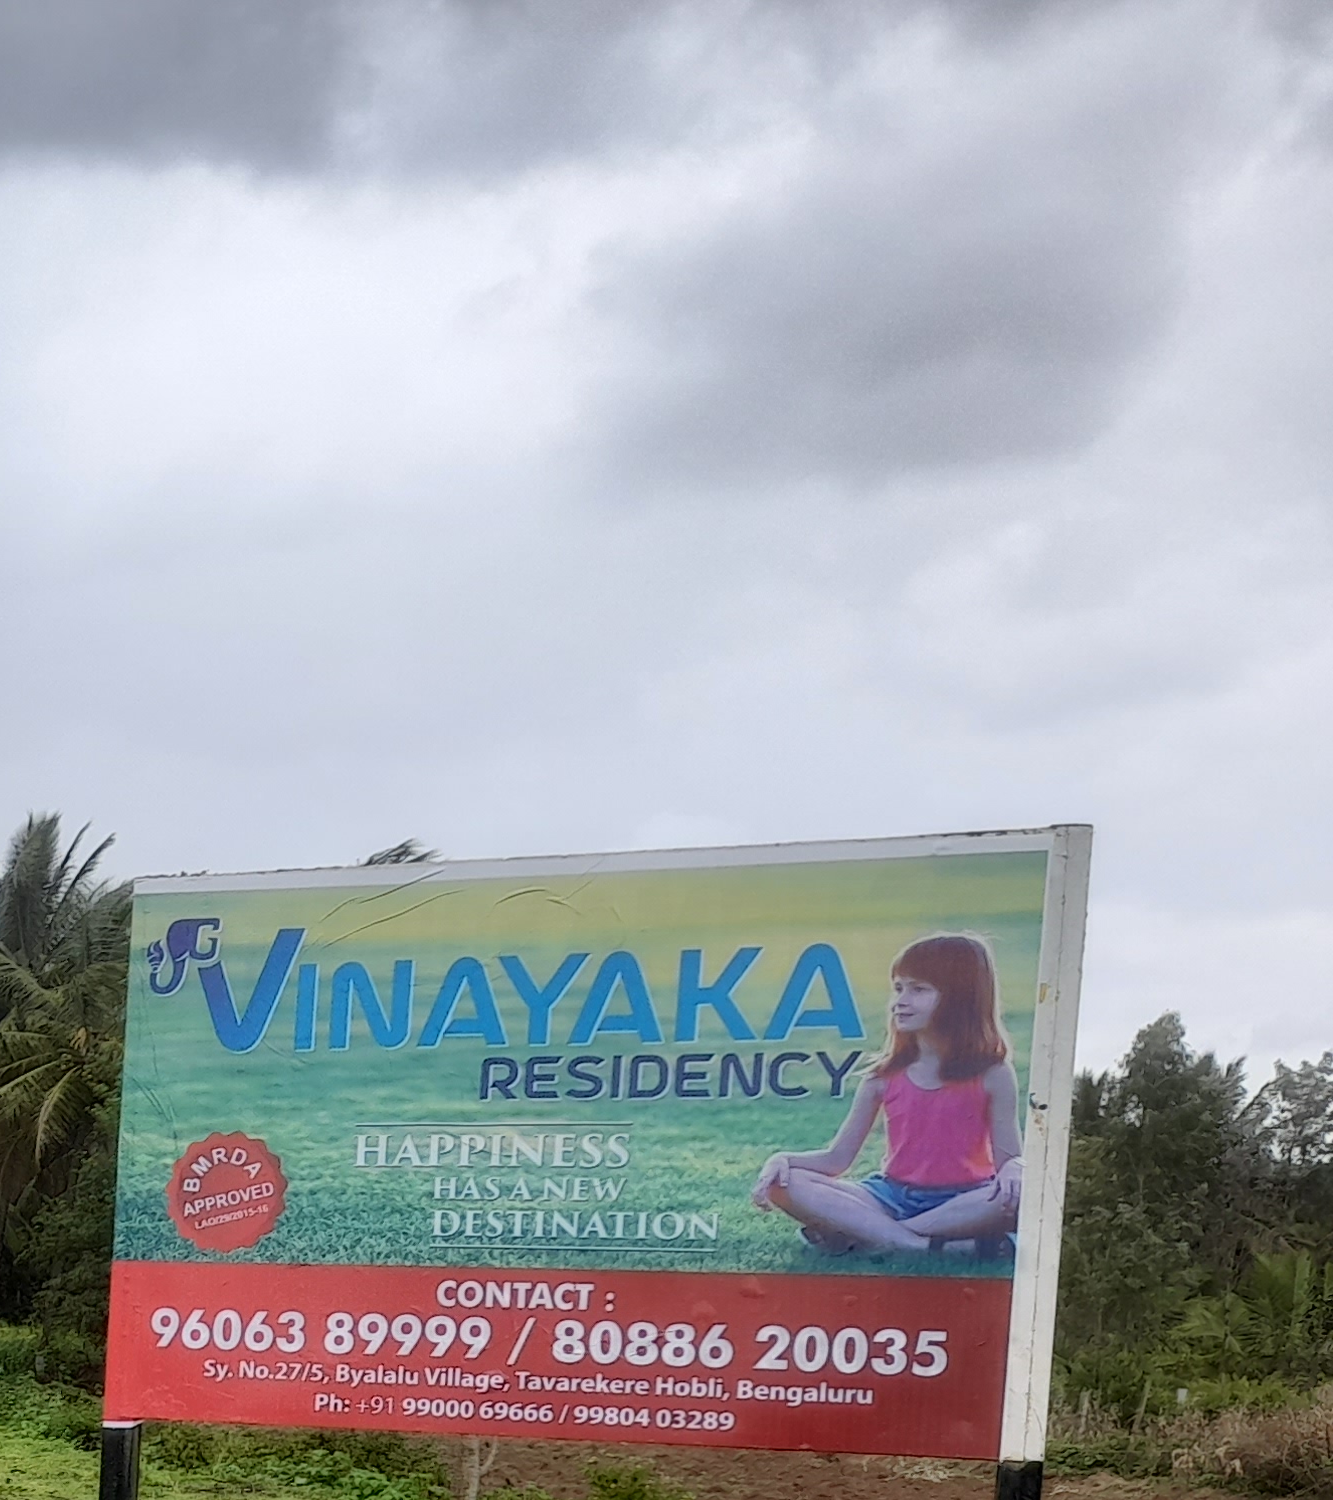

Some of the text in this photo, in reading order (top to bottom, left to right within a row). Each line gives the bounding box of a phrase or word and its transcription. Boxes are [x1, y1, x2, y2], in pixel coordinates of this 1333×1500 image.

[198, 928, 867, 1054] VINAYAKA
[479, 1050, 864, 1101] RESIDENCY
[182, 1147, 263, 1193] BMRDA
[353, 1132, 631, 1170] HAPPINESS
[183, 1182, 275, 1217] APPROVED
[434, 1176, 628, 1201] HAS A NEW
[433, 1208, 720, 1242] DESTINATION
[436, 1279, 595, 1311] CONTACT
[150, 1306, 950, 1378] 96063 89999 / 80886 20035
[203, 1359, 874, 1408] Sy. No.27/5, Byalalu Village, Tavarekere Hobli, Bengaluru
[313, 1394, 735, 1431] Ph: +91 99000 69666 / 99804 03289
